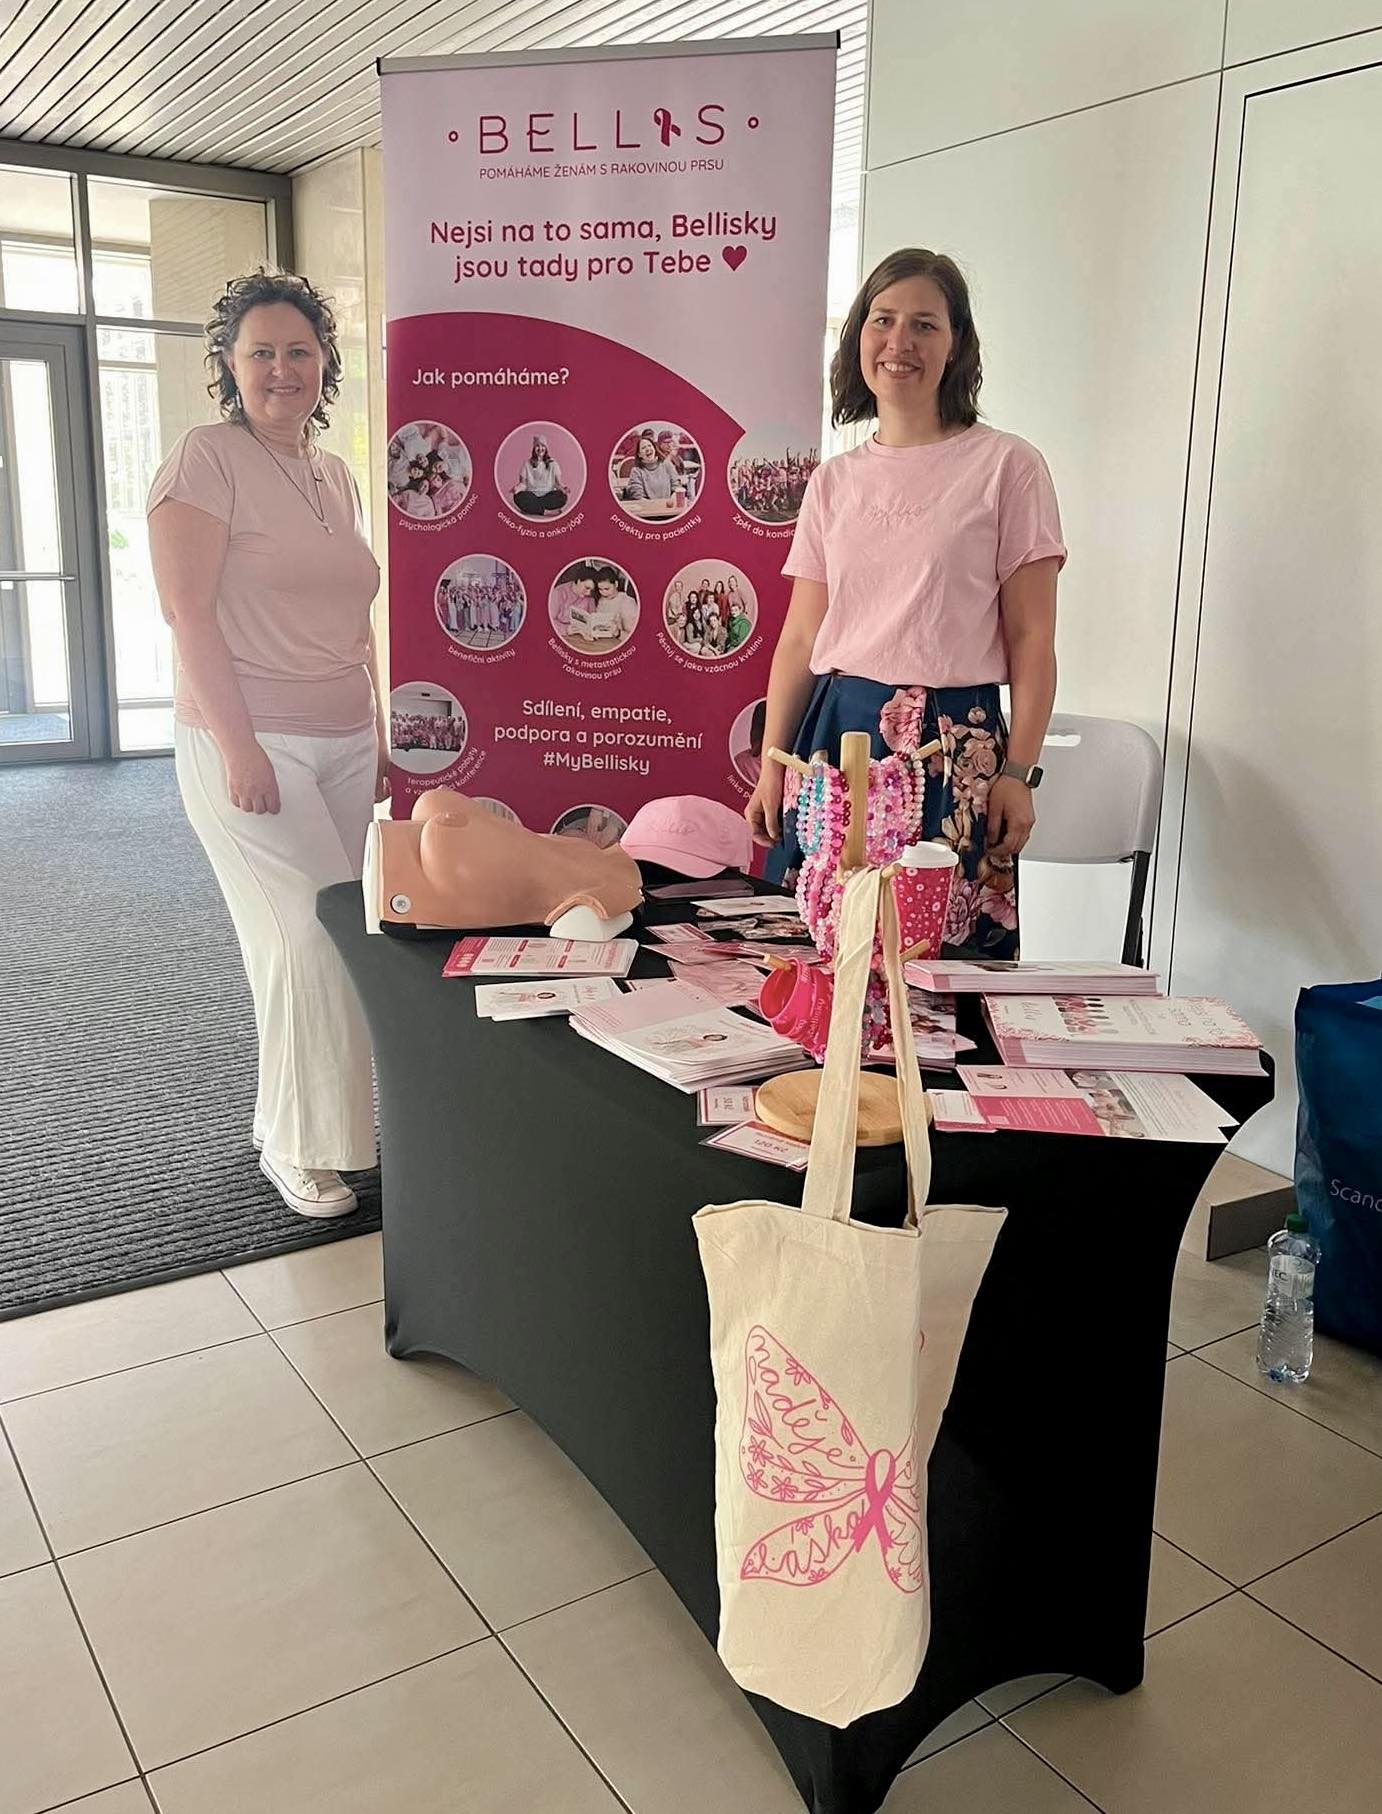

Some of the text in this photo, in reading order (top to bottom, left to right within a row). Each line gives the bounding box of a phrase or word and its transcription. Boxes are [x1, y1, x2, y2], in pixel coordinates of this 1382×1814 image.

[480, 159, 724, 179] POMÁHÁME ŽENÁM S RAKOVINOU PRSU
[431, 211, 776, 249] Nejsi na to sama, Bellisky
[454, 249, 711, 283] jsou tady pro Tebe
[412, 367, 569, 388] Jak pomáháme?
[399, 513, 457, 532] psychologická
[497, 511, 537, 538] onko-fyzio
[546, 512, 585, 538] onko-jóga
[610, 513, 702, 541] projekty pro pacientky
[732, 514, 752, 532] Zpět
[752, 527, 764, 537] do
[548, 637, 637, 669] Bellisky s metastatickou
[656, 632, 764, 673] Pěstuj se jako vzácnou květinu
[562, 663, 622, 680] rakovinou prsu
[523, 700, 672, 724] Sdílení, empatie,
[494, 725, 703, 749] podpora a porozumění
[544, 751, 650, 775] #MyBellisky
